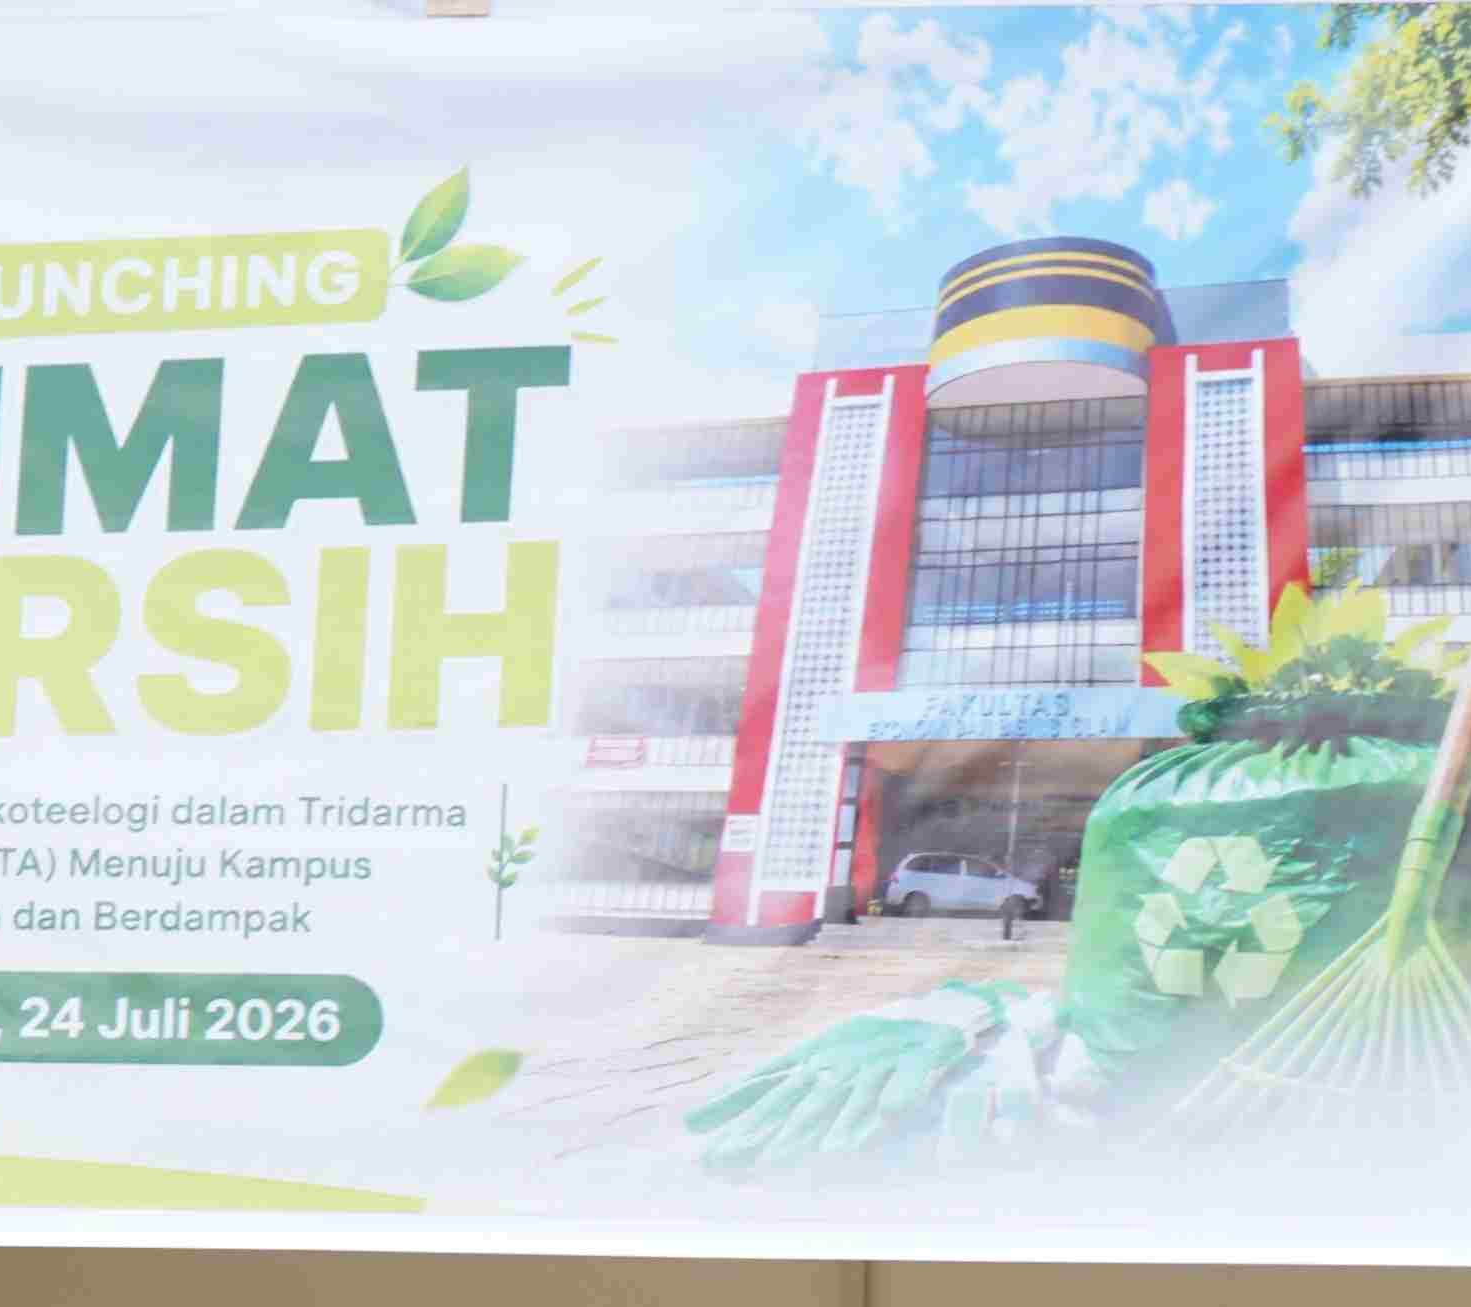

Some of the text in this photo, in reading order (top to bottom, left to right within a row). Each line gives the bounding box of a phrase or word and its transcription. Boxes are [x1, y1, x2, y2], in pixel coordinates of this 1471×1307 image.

[171, 796, 286, 828] dalam
[298, 796, 468, 830] Tridarma
[69, 847, 208, 889] Menuju
[220, 849, 374, 889] Kampus
[13, 901, 82, 933] dan
[93, 901, 313, 942] Berdampak
[19, 996, 87, 1041] 24
[97, 997, 192, 1043] Juli
[204, 998, 342, 1044] 2026
